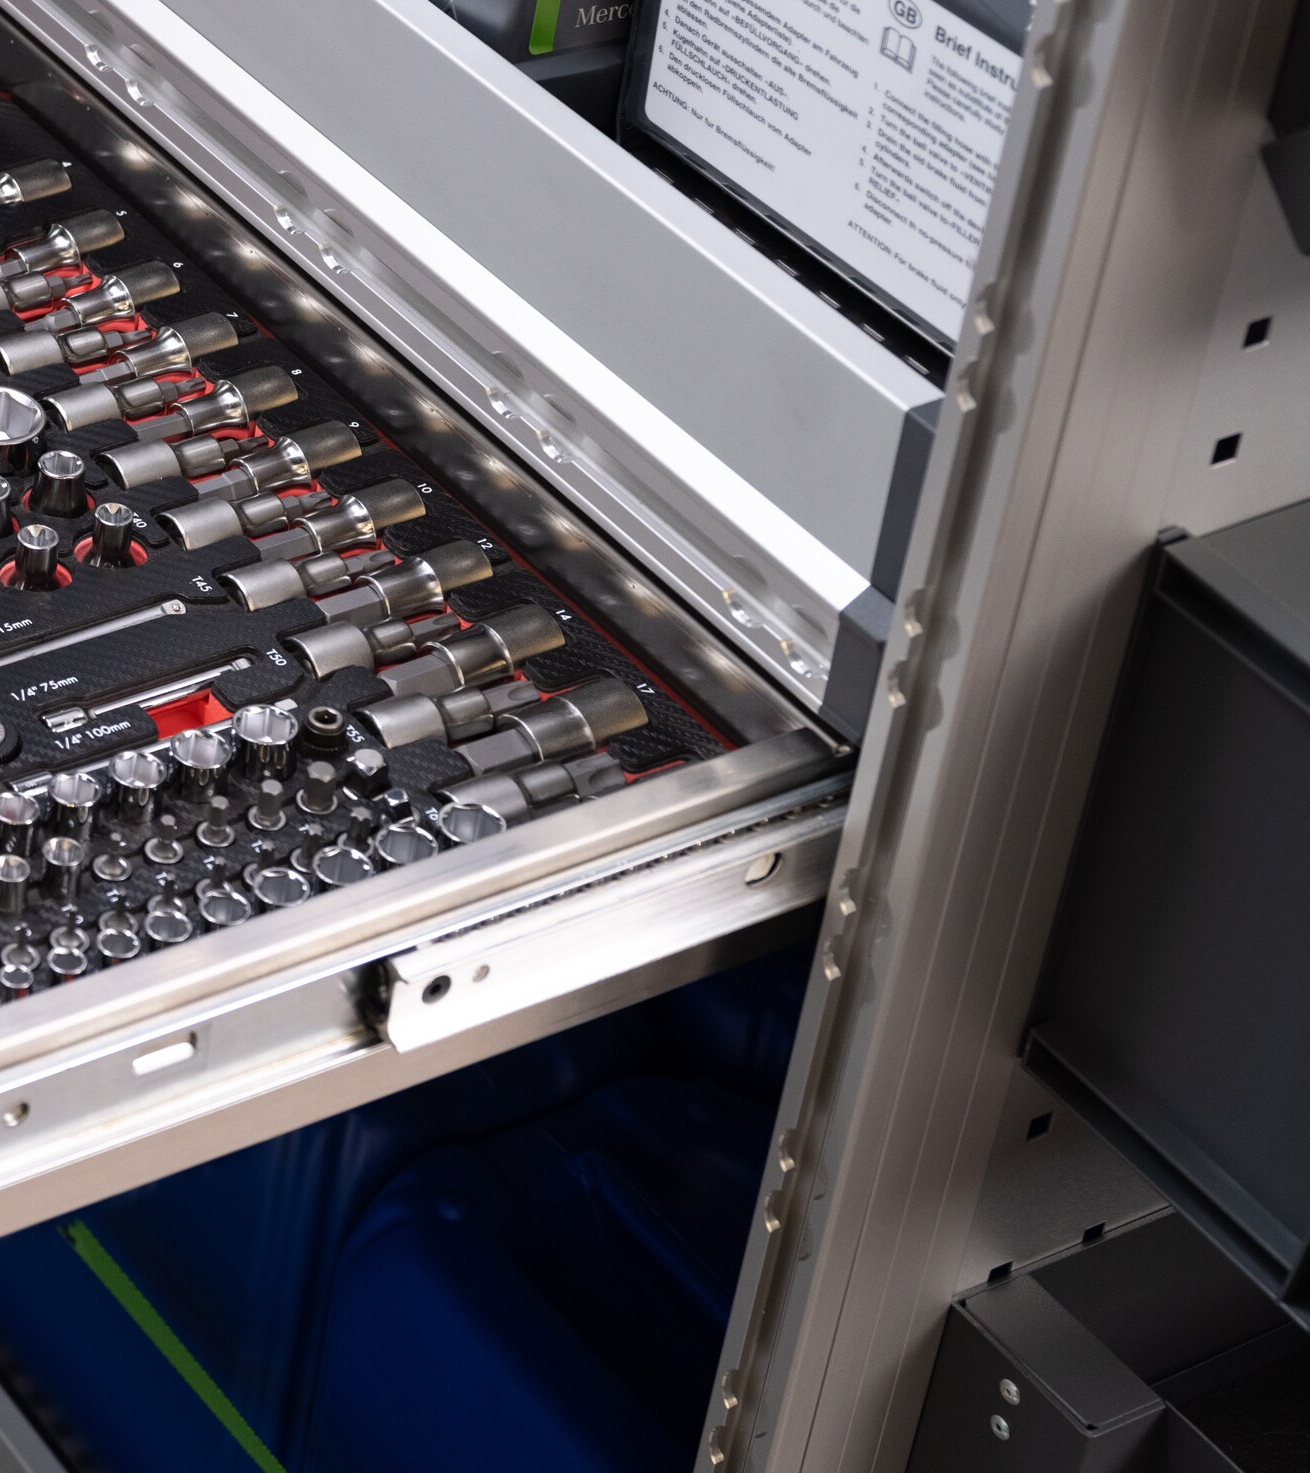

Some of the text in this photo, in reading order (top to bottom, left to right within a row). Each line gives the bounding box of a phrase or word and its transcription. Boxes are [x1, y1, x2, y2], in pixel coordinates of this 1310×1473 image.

[893, 0, 917, 28] GB
[781, 21, 811, 44] Adapter
[811, 41, 824, 54] am
[824, 48, 859, 79] Fahrzeug
[934, 24, 972, 60] Brief
[657, 44, 812, 156] 6. Den drucklosen Füllschlauch vom Adapter
[291, 368, 302, 376] 8
[417, 482, 433, 495] 10
[477, 538, 493, 550] 12
[191, 576, 212, 593] T45
[555, 609, 571, 621] 14
[266, 648, 288, 667] T50
[11, 676, 79, 702] 1/4" 75mm
[636, 683, 655, 695] 17
[55, 734, 83, 750] 1/4"
[84, 720, 132, 741] 100mm
[346, 724, 365, 743] T55
[425, 807, 439, 822] T6
